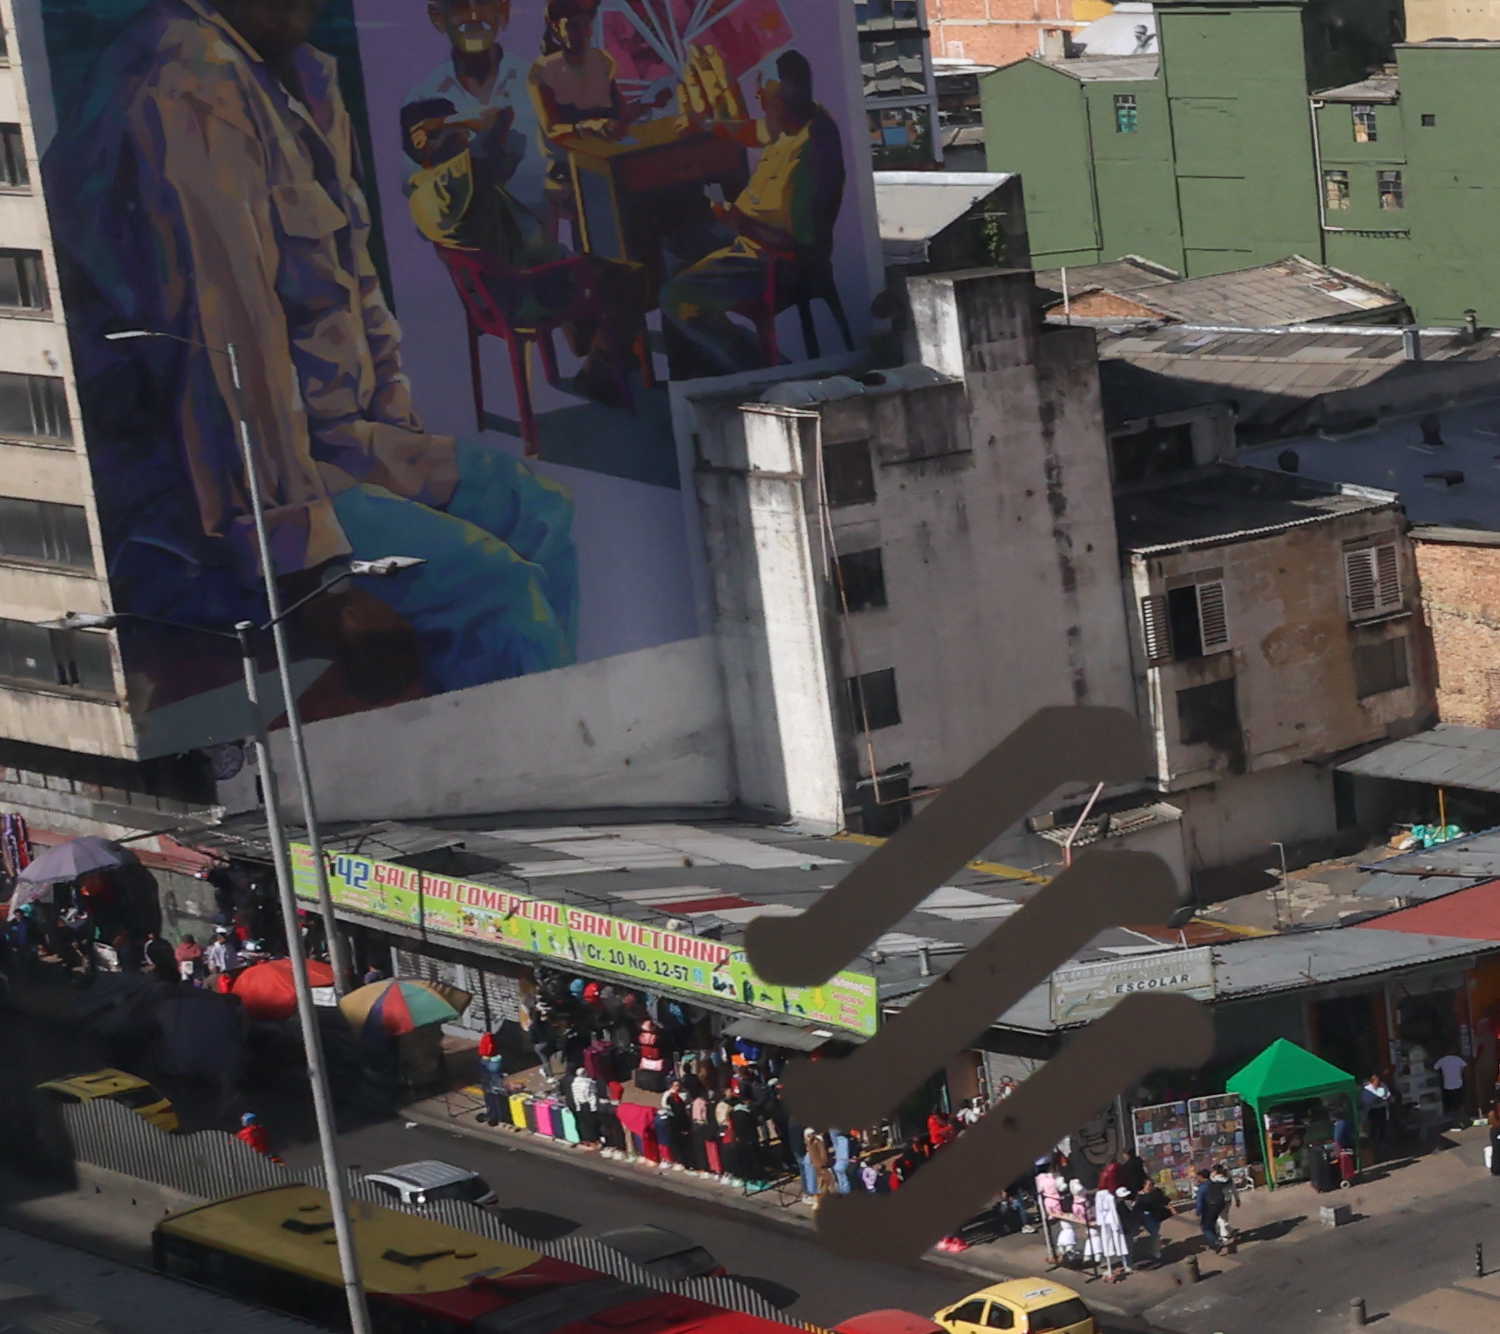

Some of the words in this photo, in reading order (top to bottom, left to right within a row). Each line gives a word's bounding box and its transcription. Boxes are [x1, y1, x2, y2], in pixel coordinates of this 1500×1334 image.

[337, 854, 369, 891] 42
[373, 864, 451, 901] GALERIA
[456, 885, 562, 927] COMERCIAL
[569, 910, 612, 938] SAN
[618, 922, 731, 967] VICTORINO
[609, 948, 625, 965] 10
[628, 954, 650, 972] No.
[655, 959, 689, 982] 12-57
[1115, 974, 1191, 994] ESCOLAR
